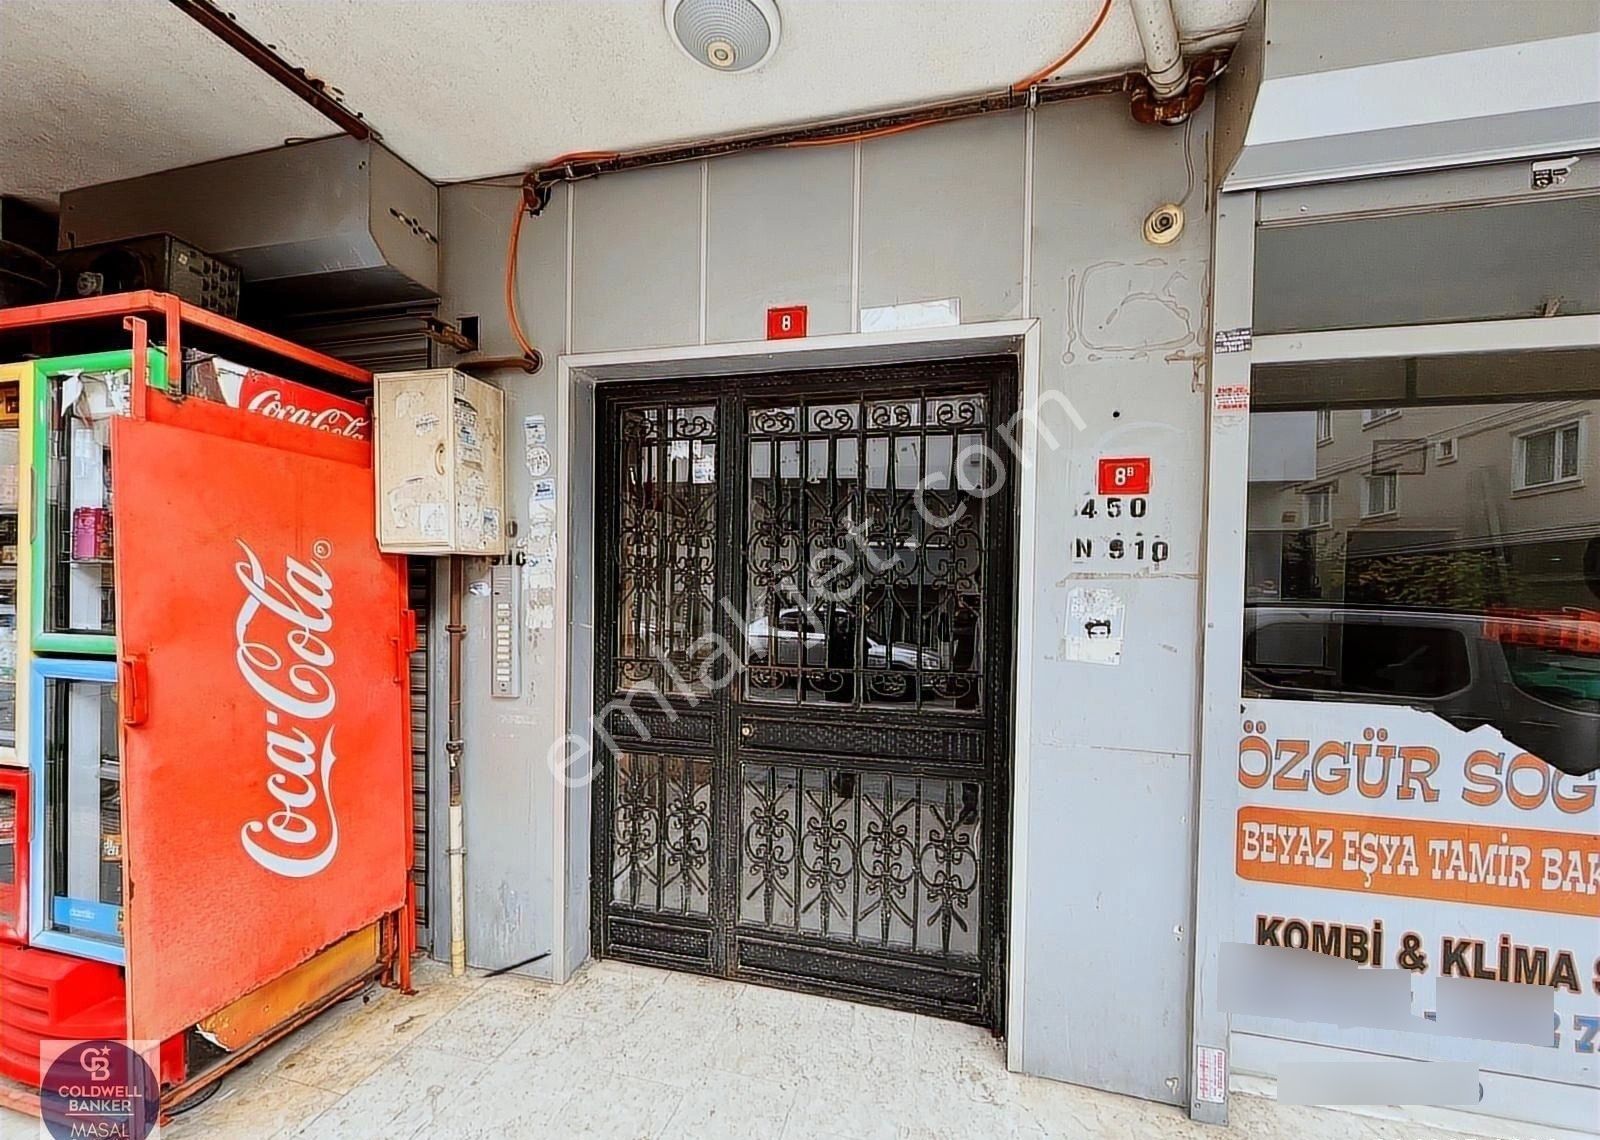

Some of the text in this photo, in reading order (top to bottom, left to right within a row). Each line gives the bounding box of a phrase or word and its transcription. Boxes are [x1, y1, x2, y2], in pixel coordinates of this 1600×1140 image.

[782, 315, 791, 331] 8
[235, 537, 339, 878] Coca-Cola
[1238, 719, 1440, 802] ÖZGÜR
[1242, 822, 1334, 869] BEYAZ
[1342, 830, 1419, 889] EŞYA
[1428, 833, 1531, 889] TAMİR
[1256, 916, 1382, 967] KOMBİ
[1398, 932, 1428, 973] &
[1441, 934, 1581, 994] KLİMA
